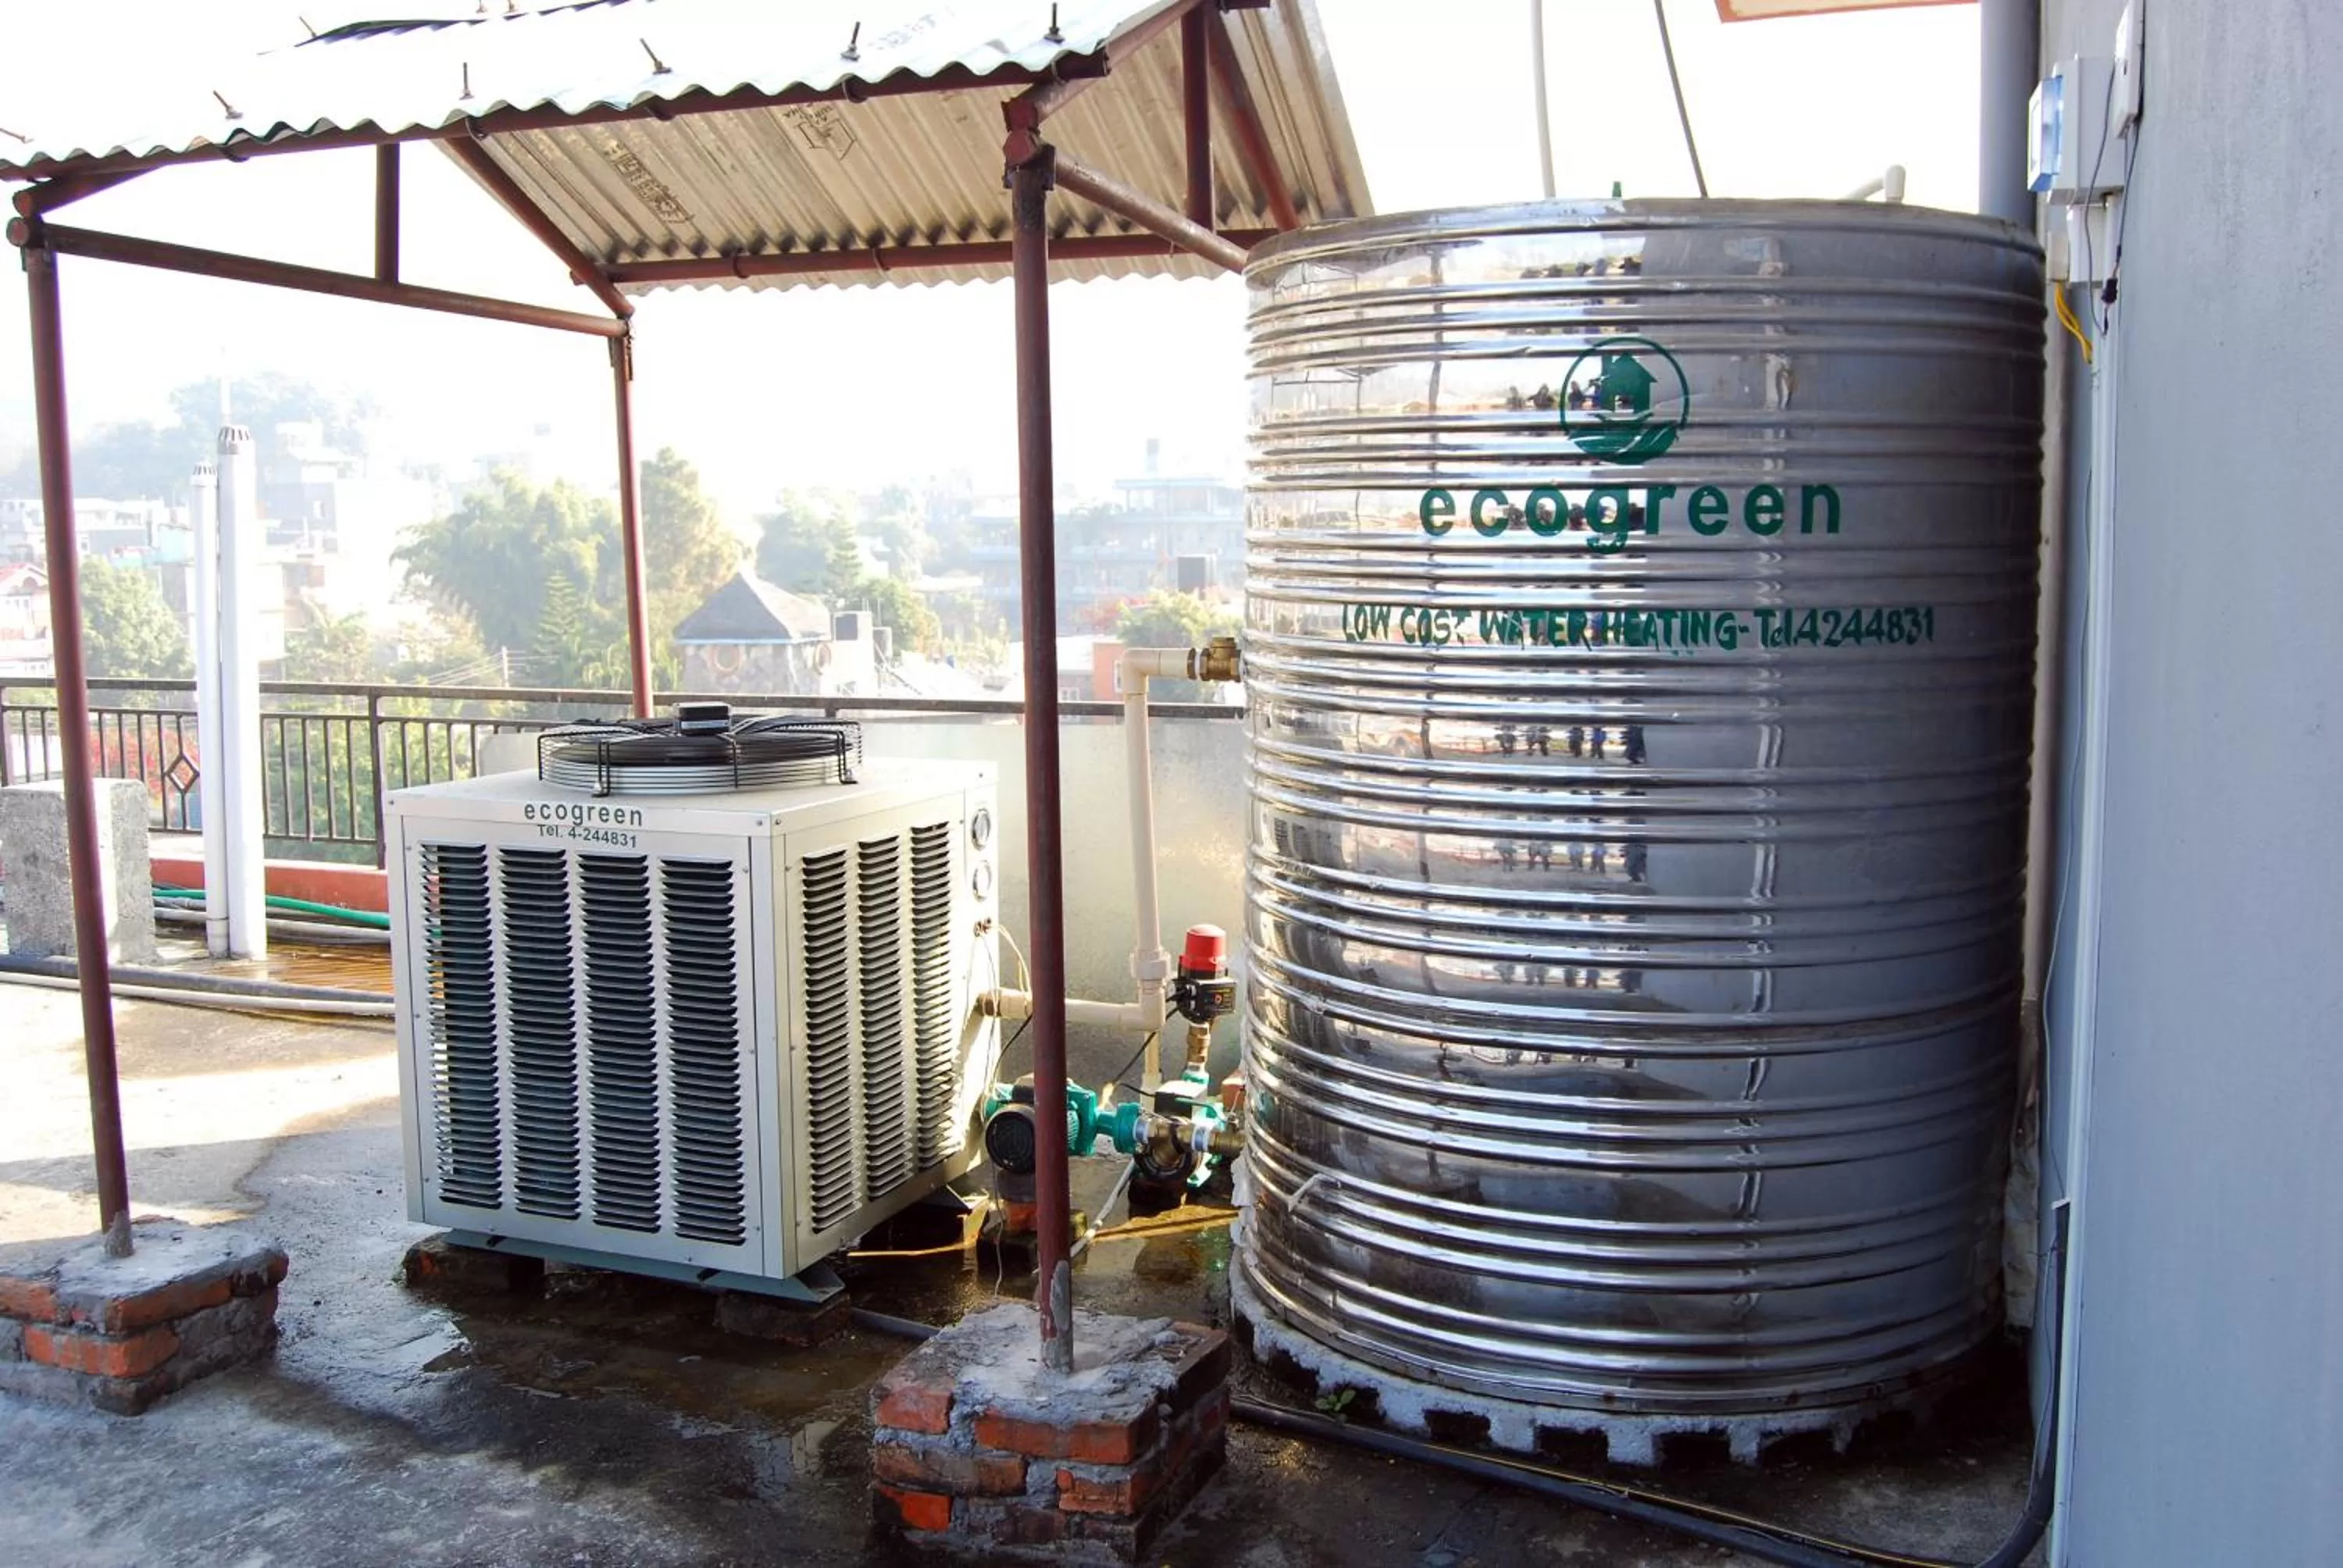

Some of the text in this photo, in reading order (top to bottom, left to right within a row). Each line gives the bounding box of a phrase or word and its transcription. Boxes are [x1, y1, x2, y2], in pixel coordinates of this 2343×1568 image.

[1419, 482, 1841, 553] ecogreen
[1342, 604, 1391, 643] LOW
[1400, 606, 1471, 648] COST
[1479, 609, 1592, 651] WATER
[524, 803, 643, 826] ecogreen
[537, 824, 637, 848] Tel. 4-244831
